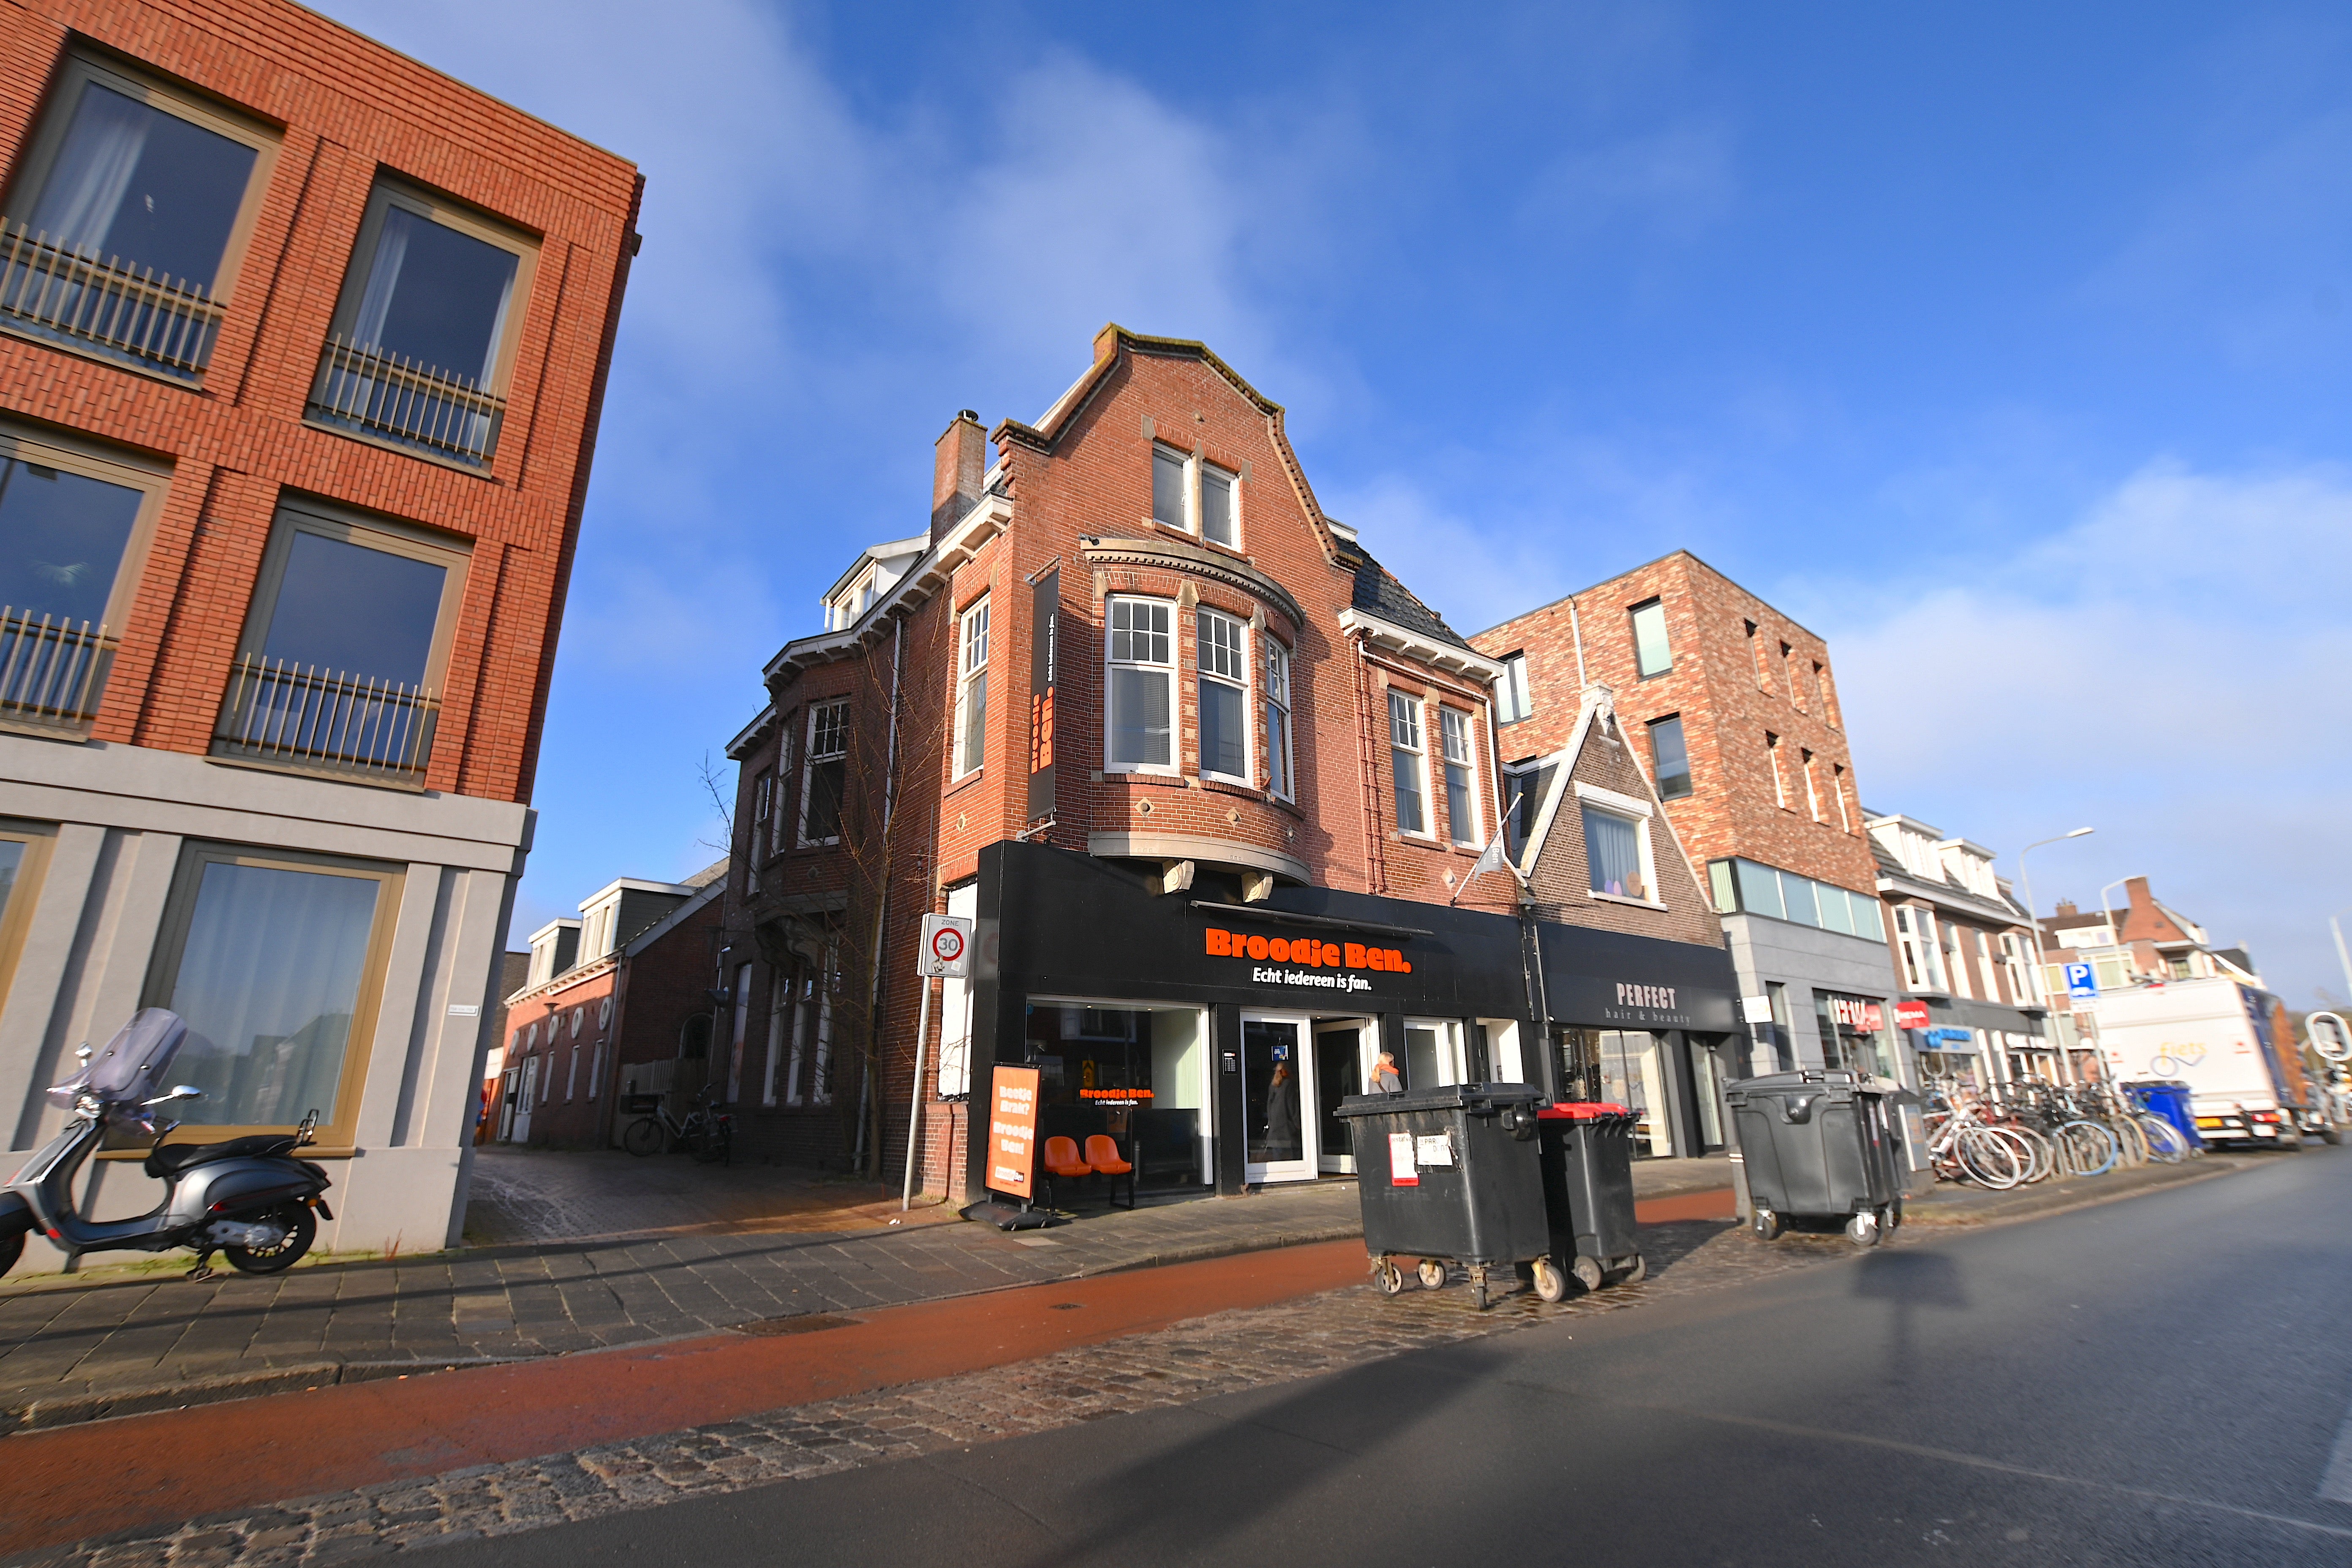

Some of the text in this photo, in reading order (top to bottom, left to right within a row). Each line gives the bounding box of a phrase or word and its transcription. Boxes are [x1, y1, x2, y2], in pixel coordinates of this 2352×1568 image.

[1031, 693, 1040, 775] Broodje
[1040, 686, 1054, 769] Ben.
[938, 937, 958, 951] 30
[1205, 927, 1413, 974] Broodje Ben.
[1252, 967, 1372, 993] Echt iedereen is fan.
[2069, 965, 2088, 985] P
[1616, 982, 1676, 1010] PERFECT
[1605, 1007, 1690, 1026] hair & beauty
[999, 1086, 1032, 1101] Beetje
[1080, 1088, 1155, 1099] Broodje Ben.
[1000, 1100, 1030, 1115] Brak?
[993, 1121, 1033, 1140] Broodje
[1001, 1139, 1024, 1155] Ben!
